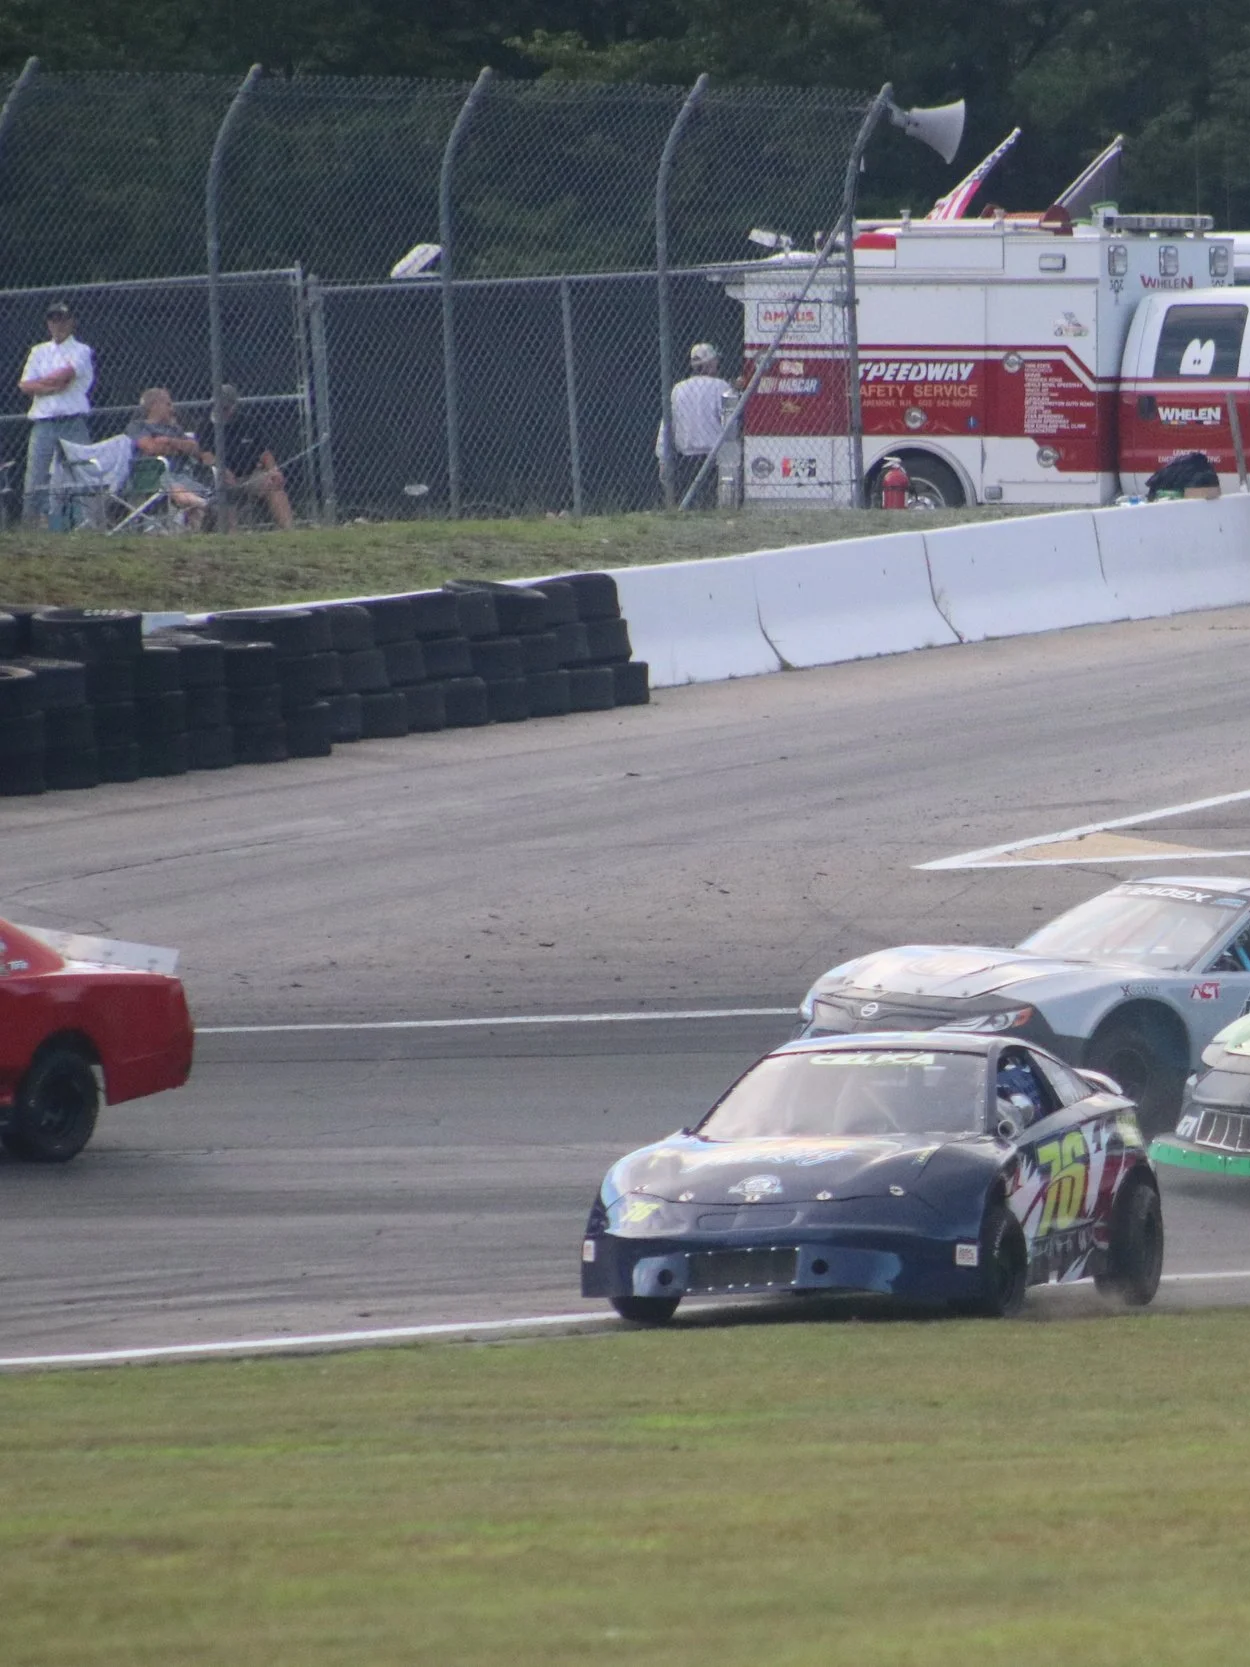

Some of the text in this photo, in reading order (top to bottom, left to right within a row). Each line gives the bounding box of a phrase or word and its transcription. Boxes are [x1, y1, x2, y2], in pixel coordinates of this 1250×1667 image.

[1139, 275, 1194, 289] WHELEN
[762, 310, 816, 322] AMUS
[859, 384, 978, 398] AFETY SERVICE
[1157, 406, 1222, 422] WHELEN
[1126, 886, 1214, 903] 240SX
[1190, 982, 1221, 1000] ACT
